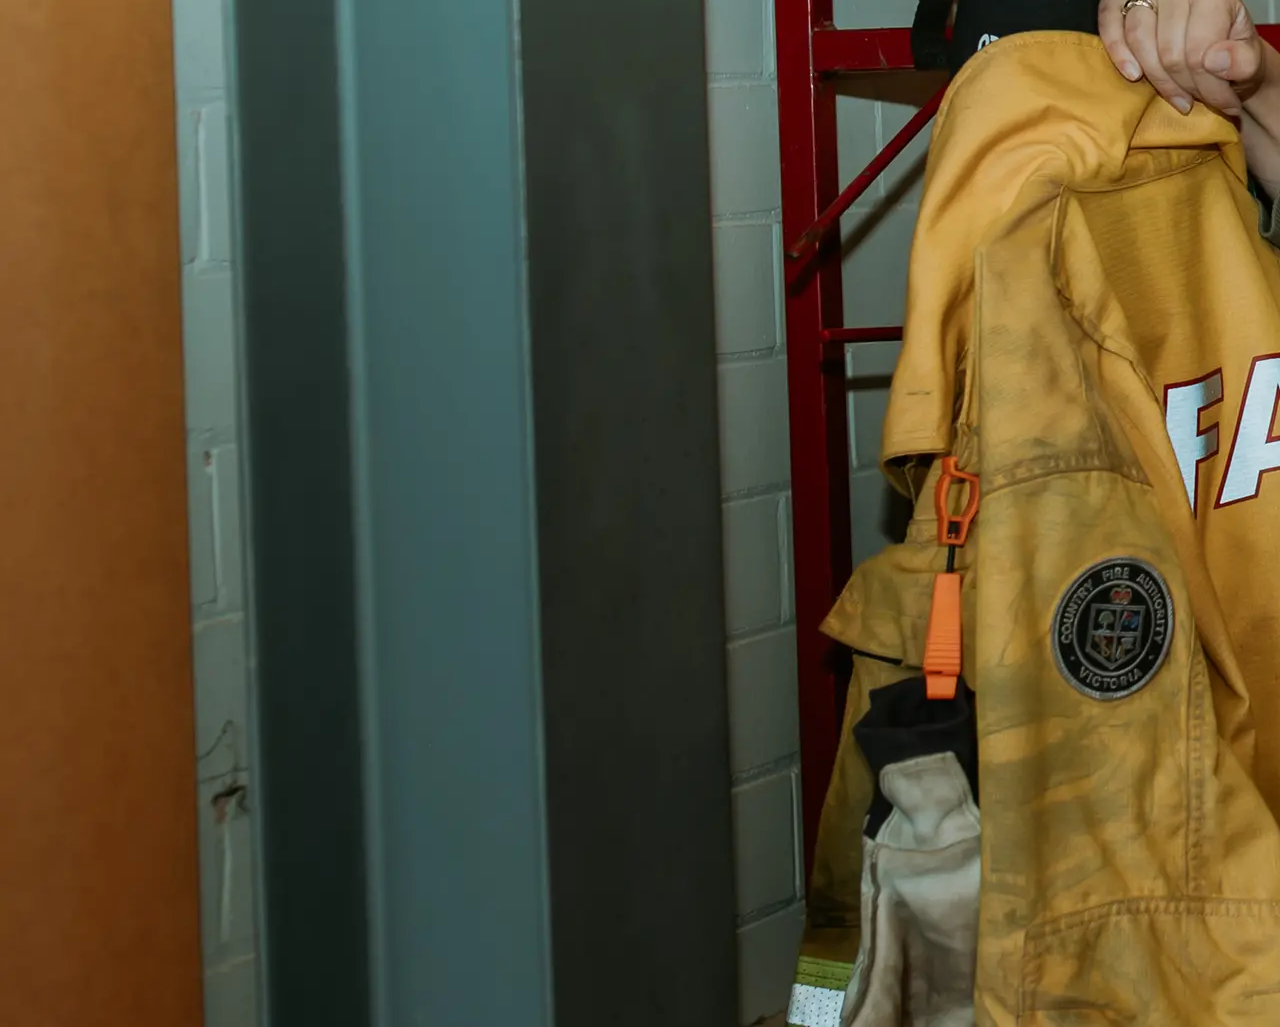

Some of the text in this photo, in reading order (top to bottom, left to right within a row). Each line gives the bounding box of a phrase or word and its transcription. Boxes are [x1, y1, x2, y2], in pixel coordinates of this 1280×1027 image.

[1060, 566, 1166, 645] COUNTRY FIRE AUTHORITY
[1079, 666, 1143, 690] VICTORIA
